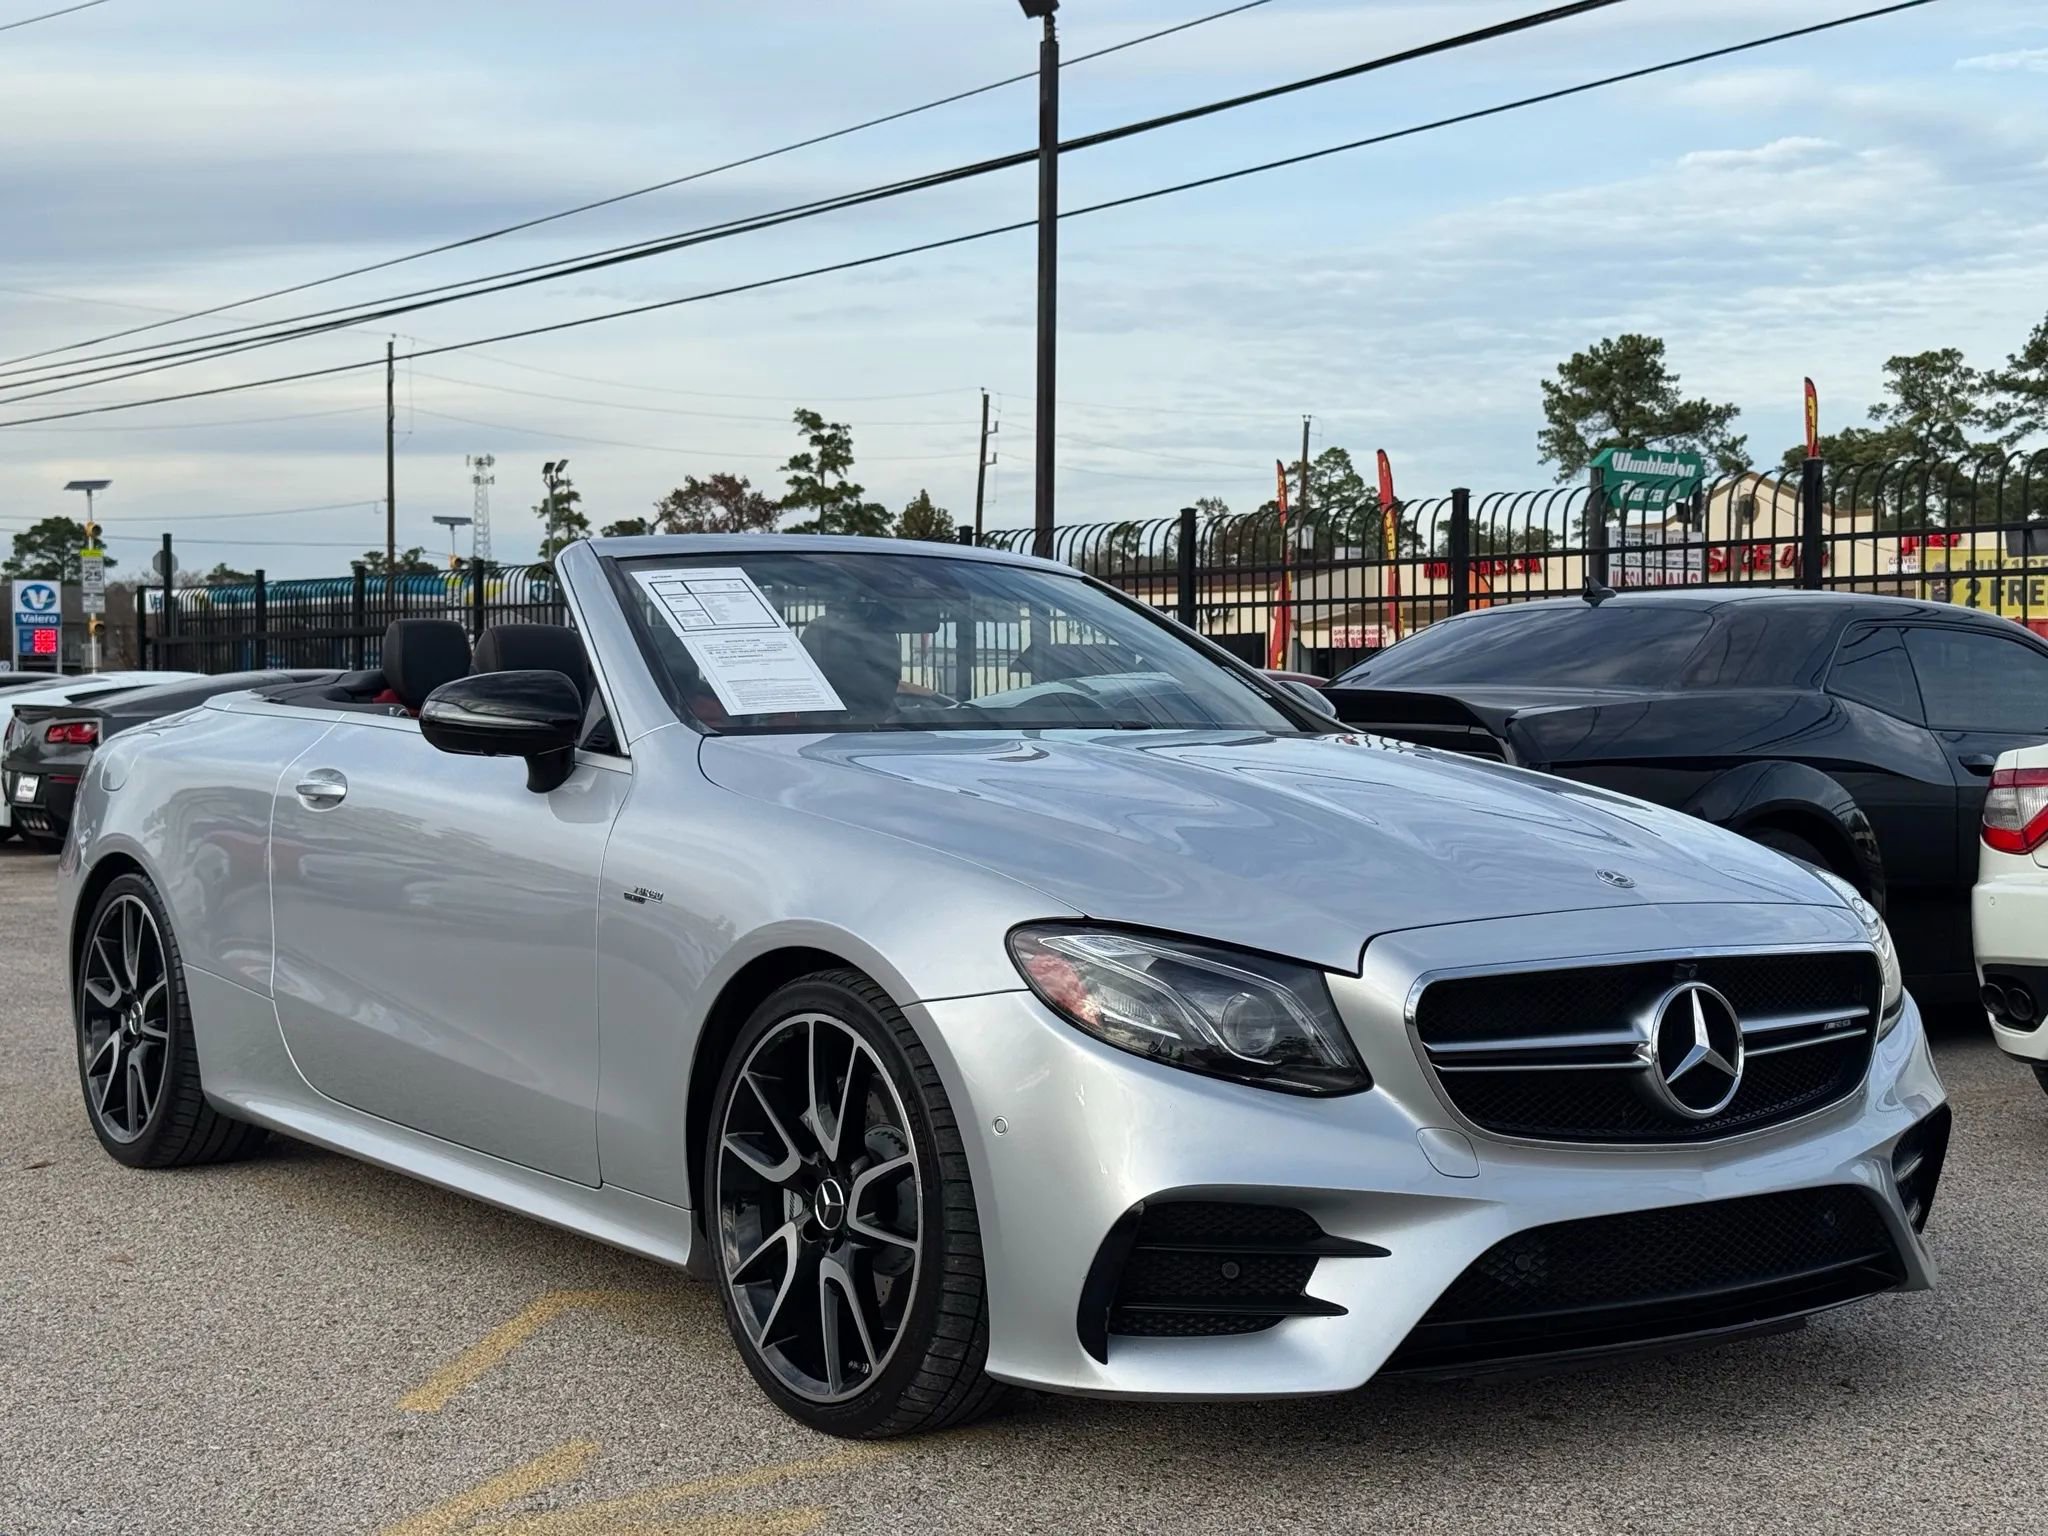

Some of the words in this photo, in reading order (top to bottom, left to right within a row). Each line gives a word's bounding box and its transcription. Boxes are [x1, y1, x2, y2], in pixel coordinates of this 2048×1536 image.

[1611, 451, 1697, 478] Wimbledon
[1618, 480, 1667, 504] Paa
[1611, 570, 1654, 587] MSSAE
[1965, 579, 1981, 608] 2
[20, 614, 57, 624] Valero
